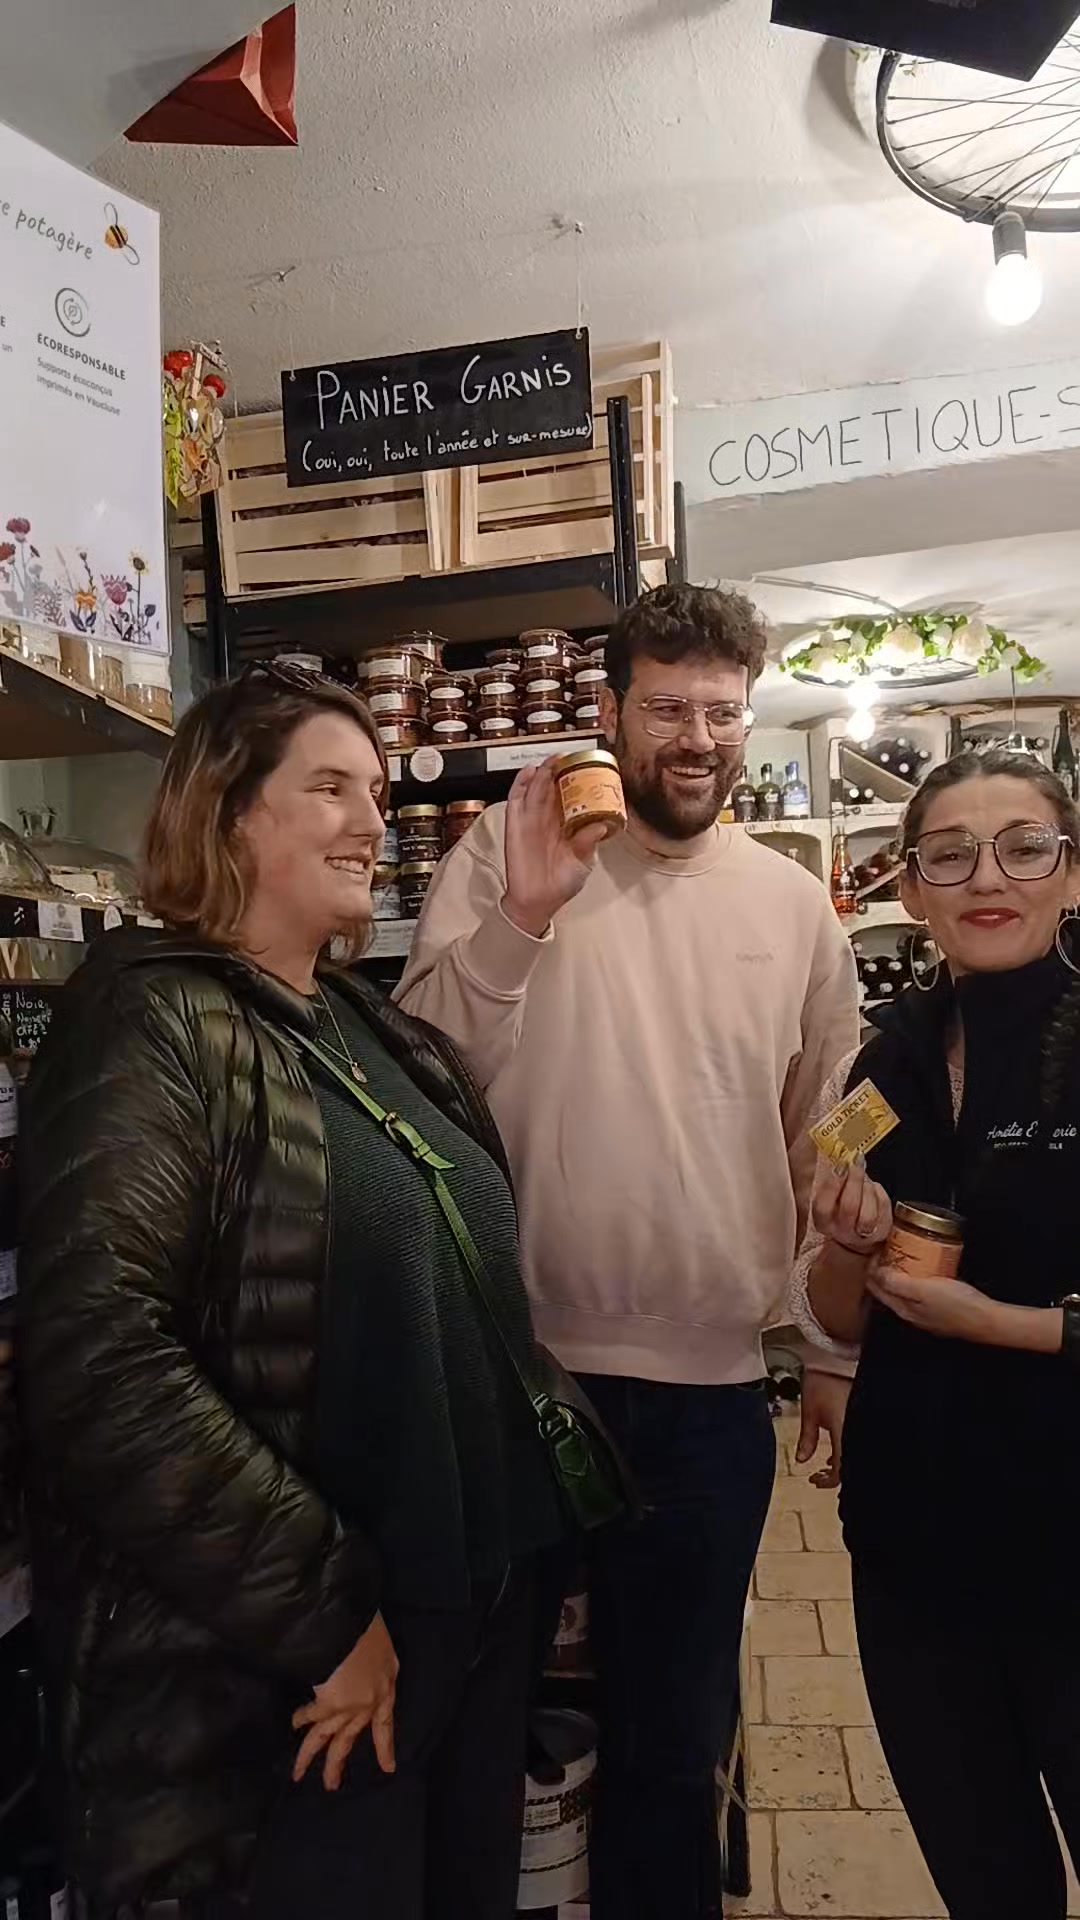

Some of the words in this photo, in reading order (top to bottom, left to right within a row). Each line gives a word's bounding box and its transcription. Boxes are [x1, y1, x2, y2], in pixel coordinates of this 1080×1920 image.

[15, 208, 93, 260] potagère
[37, 333, 126, 381] ECORESPONSABLE
[37, 356, 71, 380] Supports
[74, 391, 85, 401] en
[346, 447, 373, 472] oui,
[383, 439, 420, 462] toute
[483, 428, 500, 448] et
[821, 1115, 844, 1138] GOLD
[840, 1091, 870, 1118] TICKET
